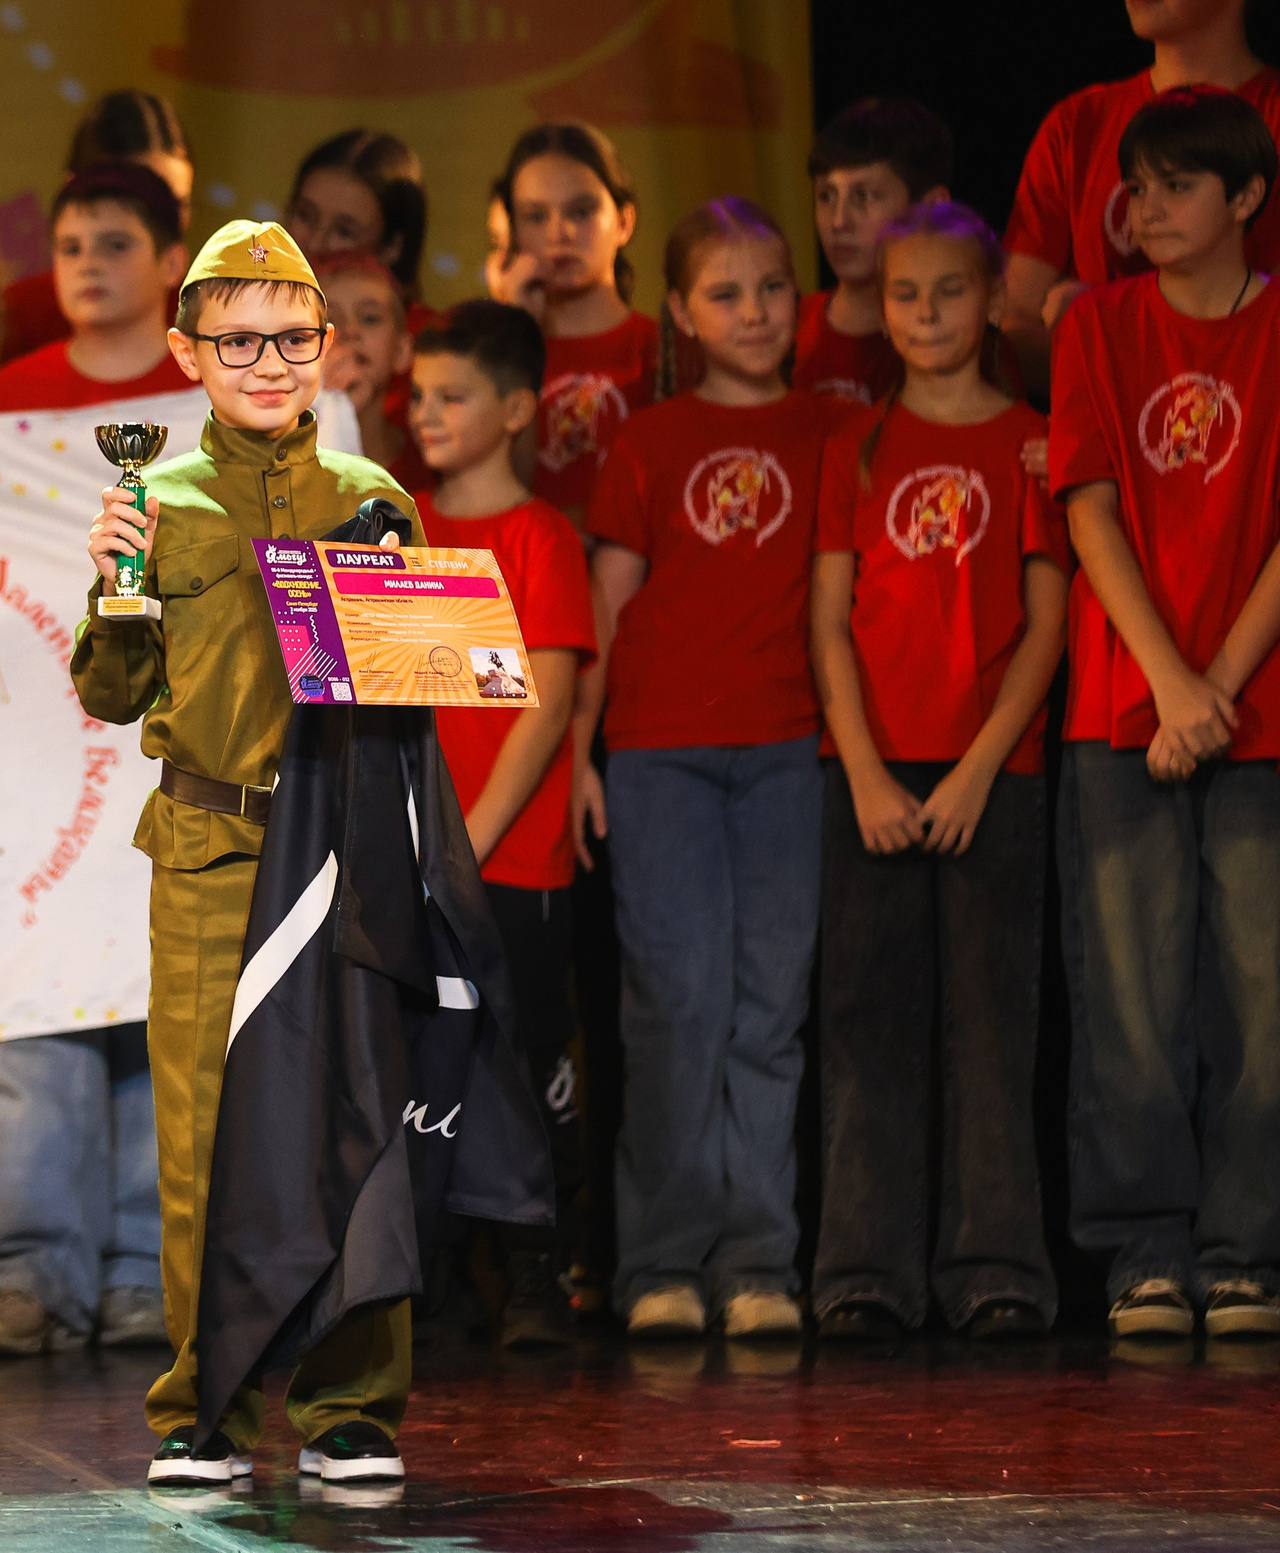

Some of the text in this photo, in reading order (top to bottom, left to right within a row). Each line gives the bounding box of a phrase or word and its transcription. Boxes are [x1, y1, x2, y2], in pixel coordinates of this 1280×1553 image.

[336, 553, 394, 567] ЛАУРЕАТ
[428, 560, 469, 570] СТЕПЕНИ
[384, 580, 445, 590] МИЛАЕВ ДАНИИЛ
